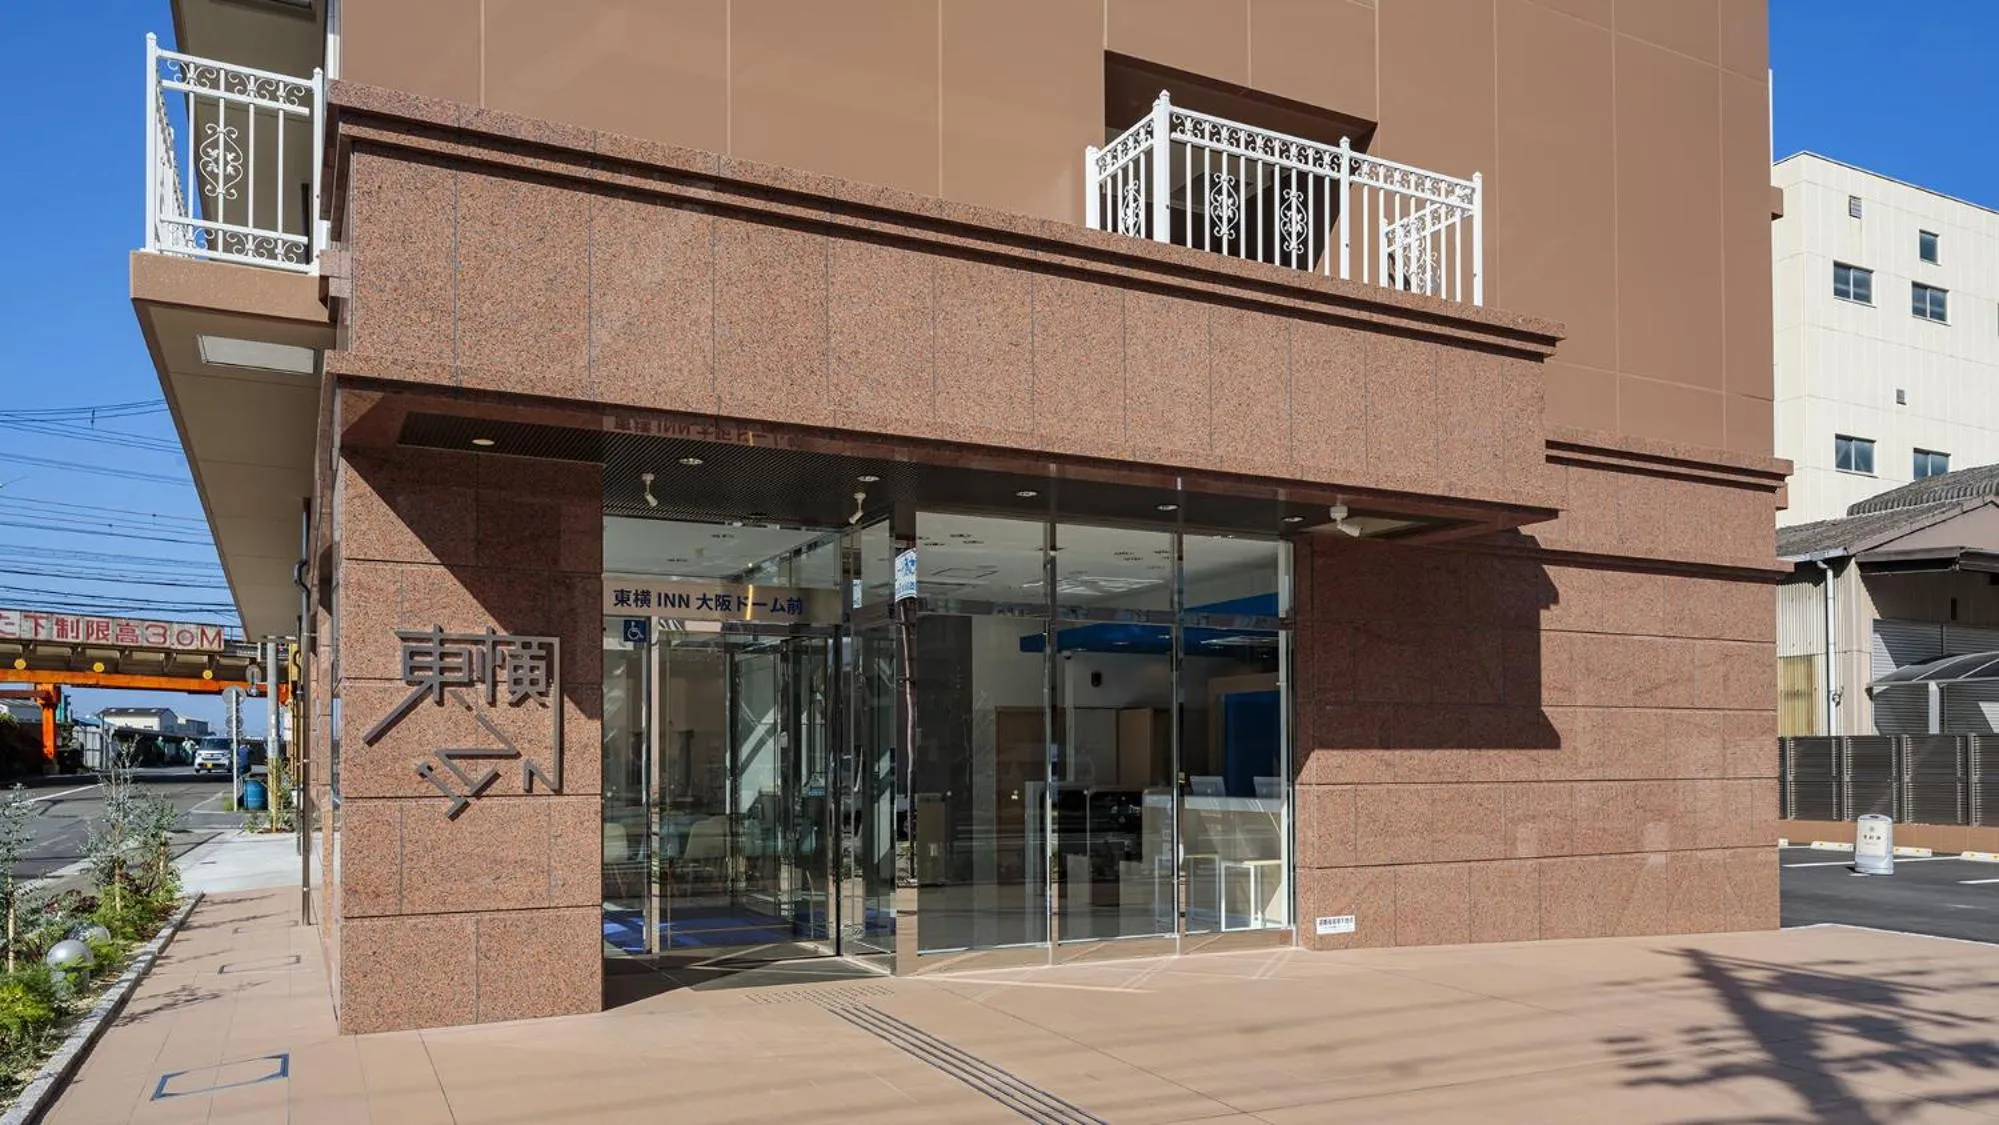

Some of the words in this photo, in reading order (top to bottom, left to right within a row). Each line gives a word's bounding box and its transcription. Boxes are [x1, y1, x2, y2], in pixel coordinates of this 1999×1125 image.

[613, 588, 651, 608] 東横
[657, 591, 690, 609] INN
[695, 593, 803, 616] 大阪ドーム前
